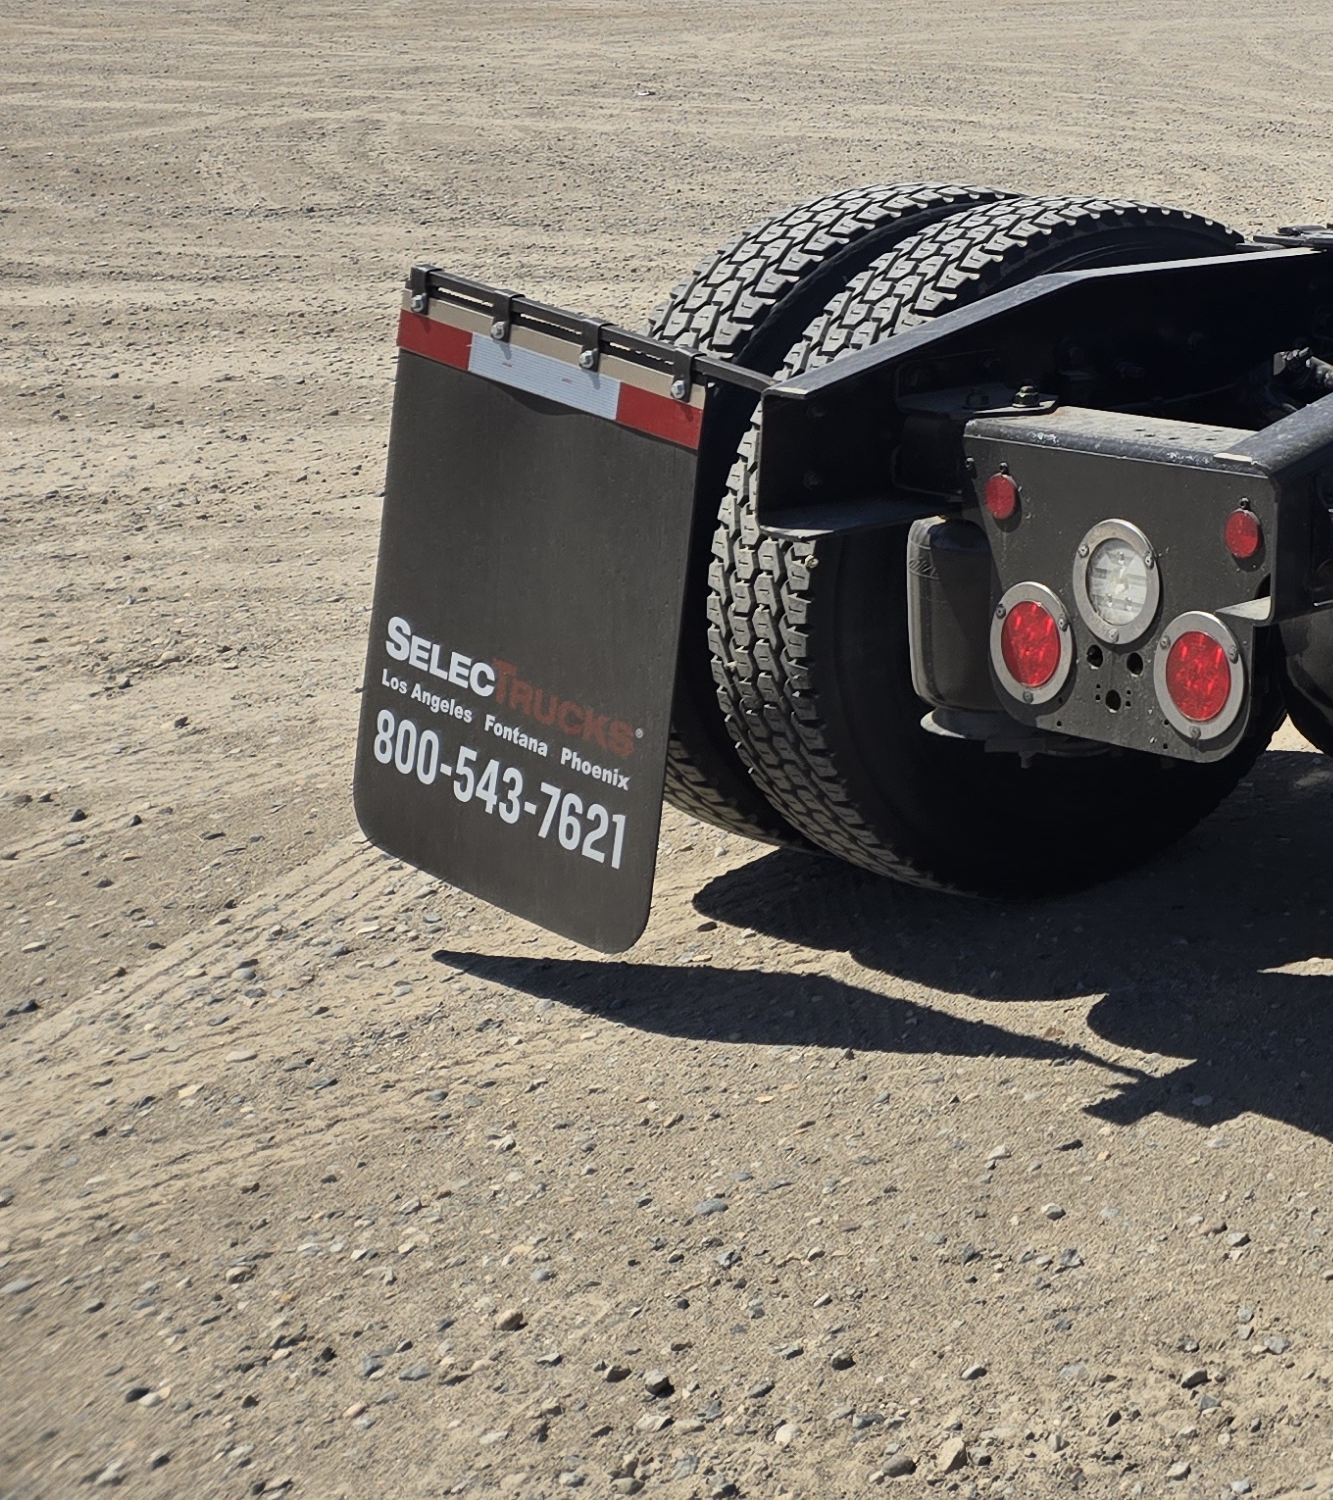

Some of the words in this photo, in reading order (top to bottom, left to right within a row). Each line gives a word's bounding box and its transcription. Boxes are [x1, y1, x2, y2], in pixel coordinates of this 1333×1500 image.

[373, 709, 627, 869] 800-543-7621
[381, 668, 408, 694] Los
[411, 682, 473, 723] Angeles
[484, 714, 548, 757] Fontana
[560, 747, 631, 790] Phoenix
